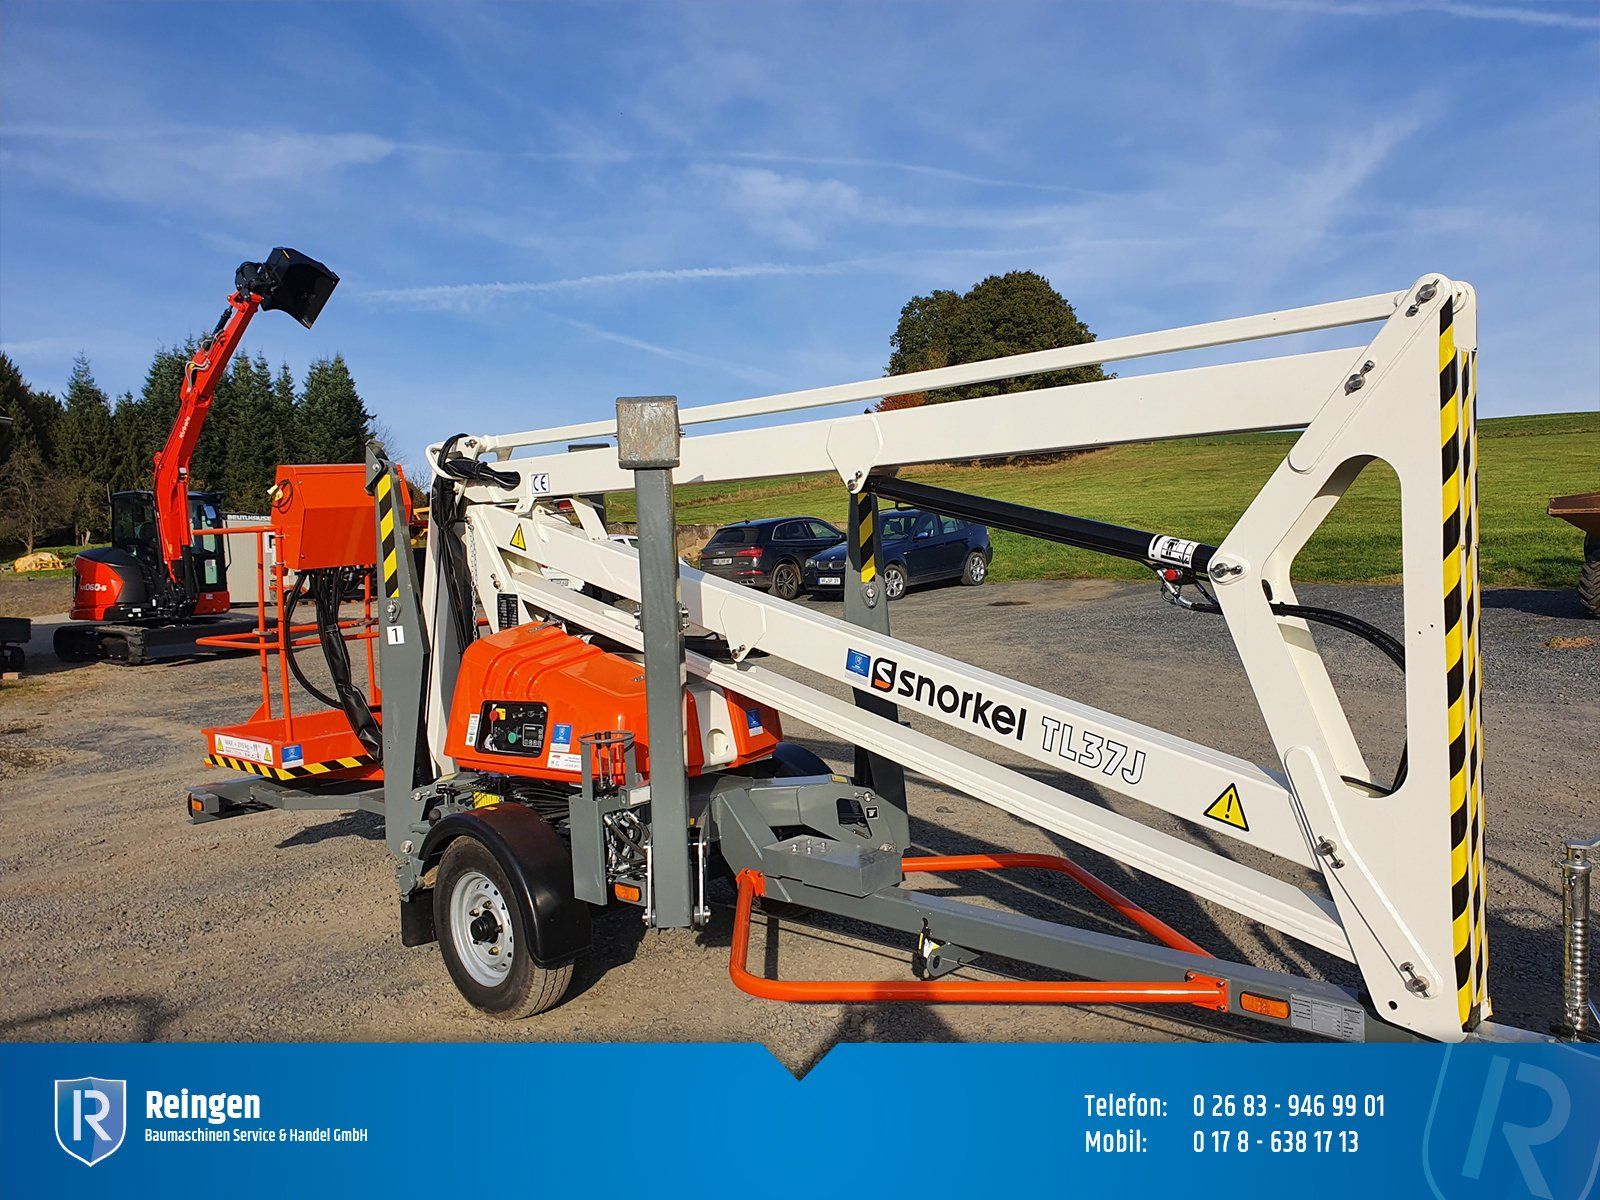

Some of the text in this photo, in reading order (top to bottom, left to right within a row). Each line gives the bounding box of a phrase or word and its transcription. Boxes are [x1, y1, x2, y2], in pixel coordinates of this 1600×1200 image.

[533, 474, 548, 492] CE
[391, 627, 399, 643] 1
[897, 669, 1027, 741] snorkel
[1041, 715, 1146, 785] TL37J
